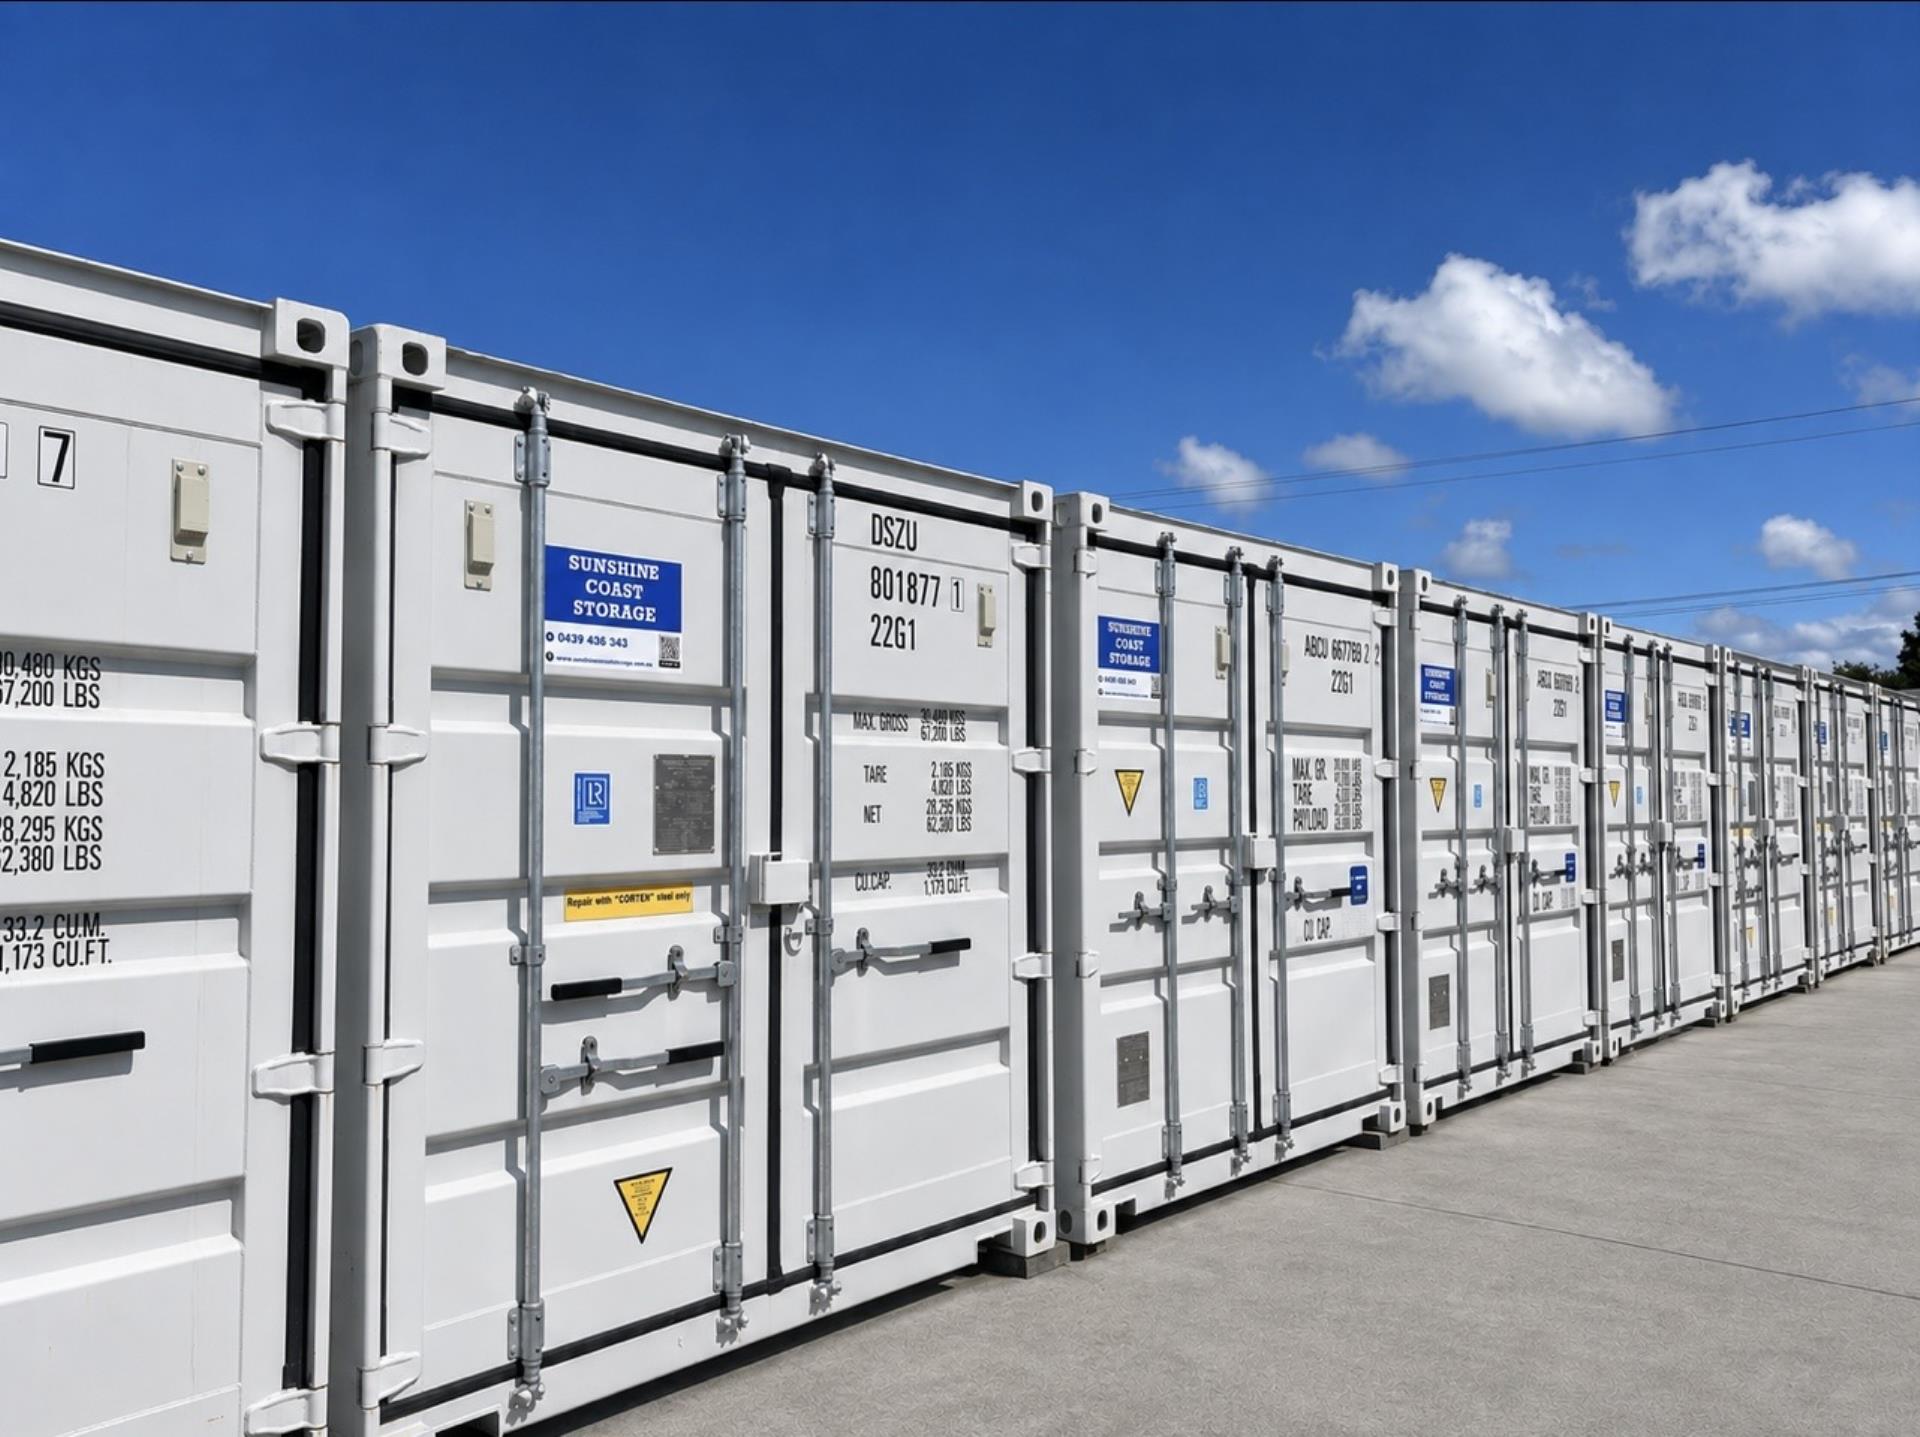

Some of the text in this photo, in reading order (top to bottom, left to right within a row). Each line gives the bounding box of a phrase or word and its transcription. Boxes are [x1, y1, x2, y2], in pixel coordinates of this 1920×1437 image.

[44, 431, 70, 482] 7
[871, 513, 917, 551] DSZU
[569, 554, 660, 581] SUNSHINE
[585, 578, 643, 600] COAST
[870, 565, 940, 607] 801877
[573, 600, 656, 622] STORAGE
[557, 632, 584, 645] 0439
[870, 613, 915, 651] 22G1
[64, 654, 101, 681] KGS
[1331, 669, 1353, 694] 22G1
[64, 682, 100, 708] LBS
[879, 711, 909, 732] GROSS
[950, 726, 966, 742] LBS
[4, 750, 105, 780] 2,185 KGS
[863, 765, 887, 783] TARE
[3, 780, 103, 809] 4,820 LBS
[956, 779, 971, 795] LBS
[863, 804, 882, 823] NET
[956, 816, 972, 833] LBS
[0, 815, 103, 845] 8,295 KGS
[0, 844, 102, 875] 2,380 LBS
[566, 897, 593, 908] Repair
[596, 896, 612, 905] with
[675, 891, 690, 902] only
[3, 912, 105, 942] 33.2 CU.M.
[53, 938, 112, 967] CU.FT.
